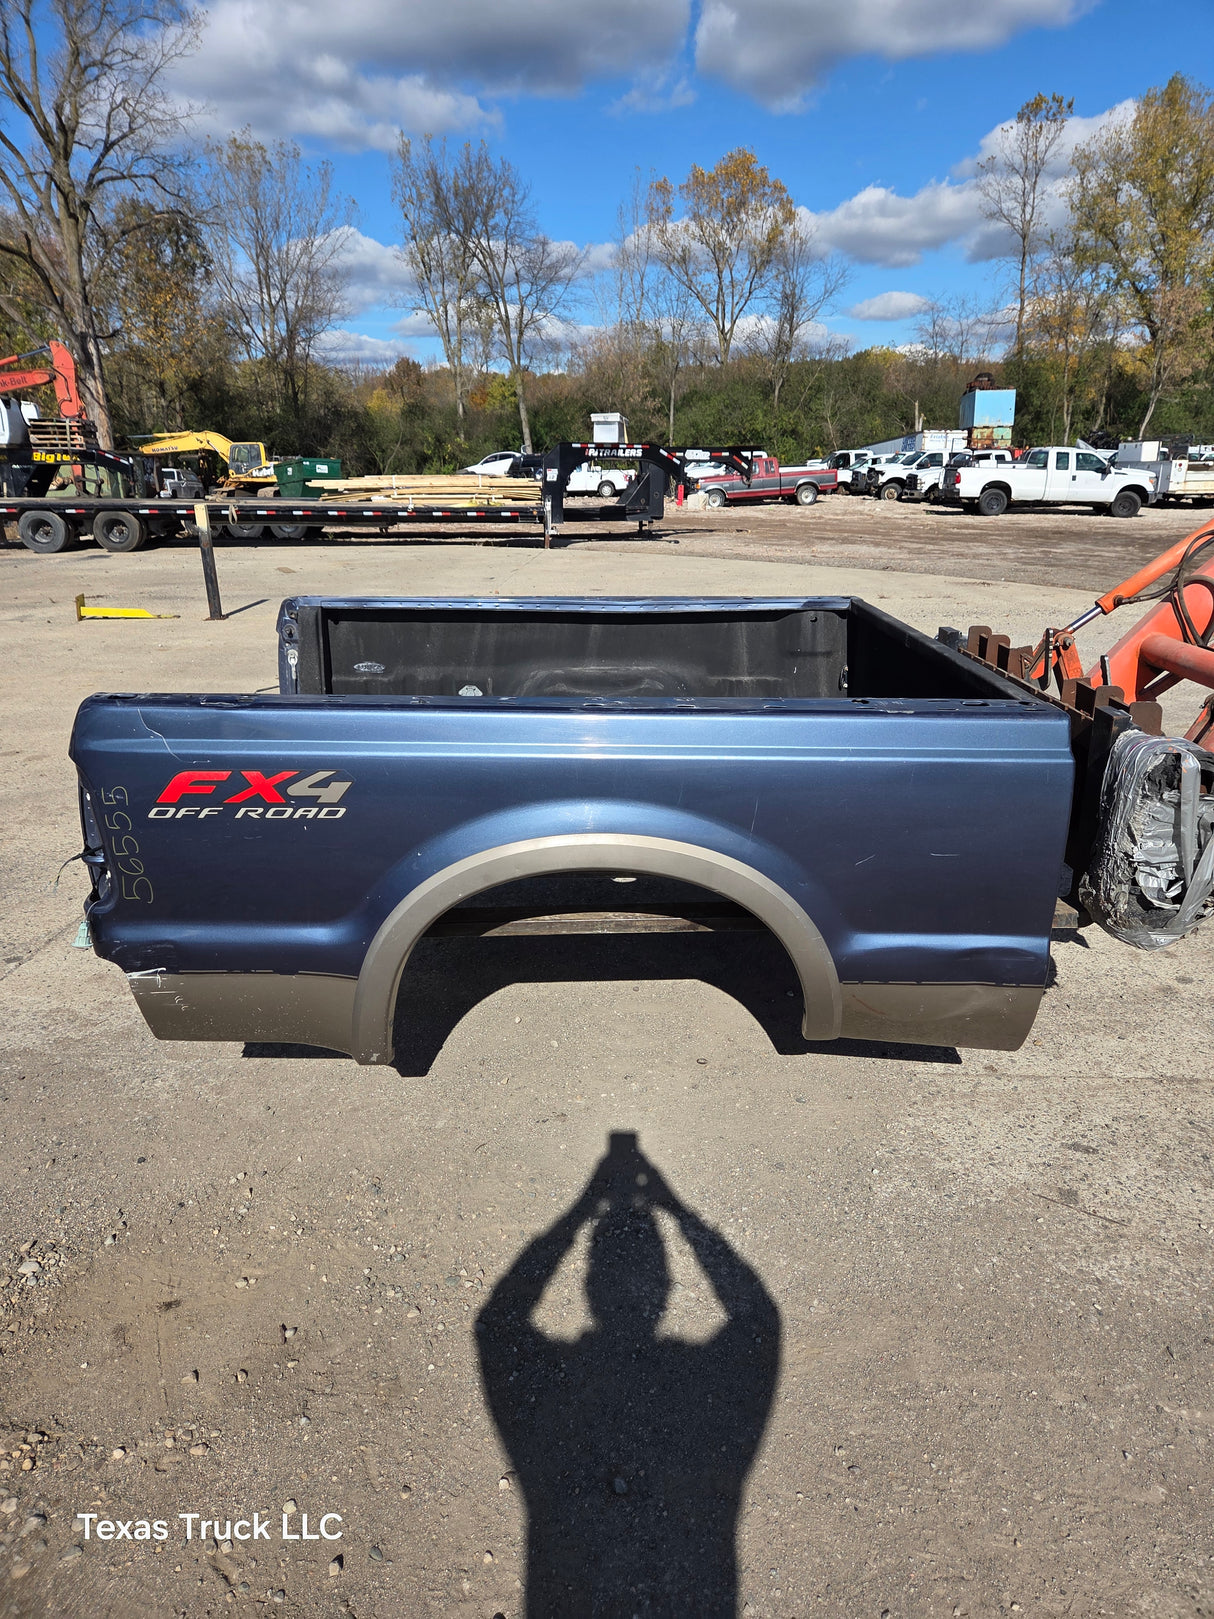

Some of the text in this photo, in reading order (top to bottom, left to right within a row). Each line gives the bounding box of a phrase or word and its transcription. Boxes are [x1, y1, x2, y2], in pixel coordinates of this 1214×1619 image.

[599, 448, 643, 457] TRAILERS
[155, 769, 353, 804] FX4
[148, 806, 347, 819] OFF ROAD
[103, 785, 154, 904] 56555
